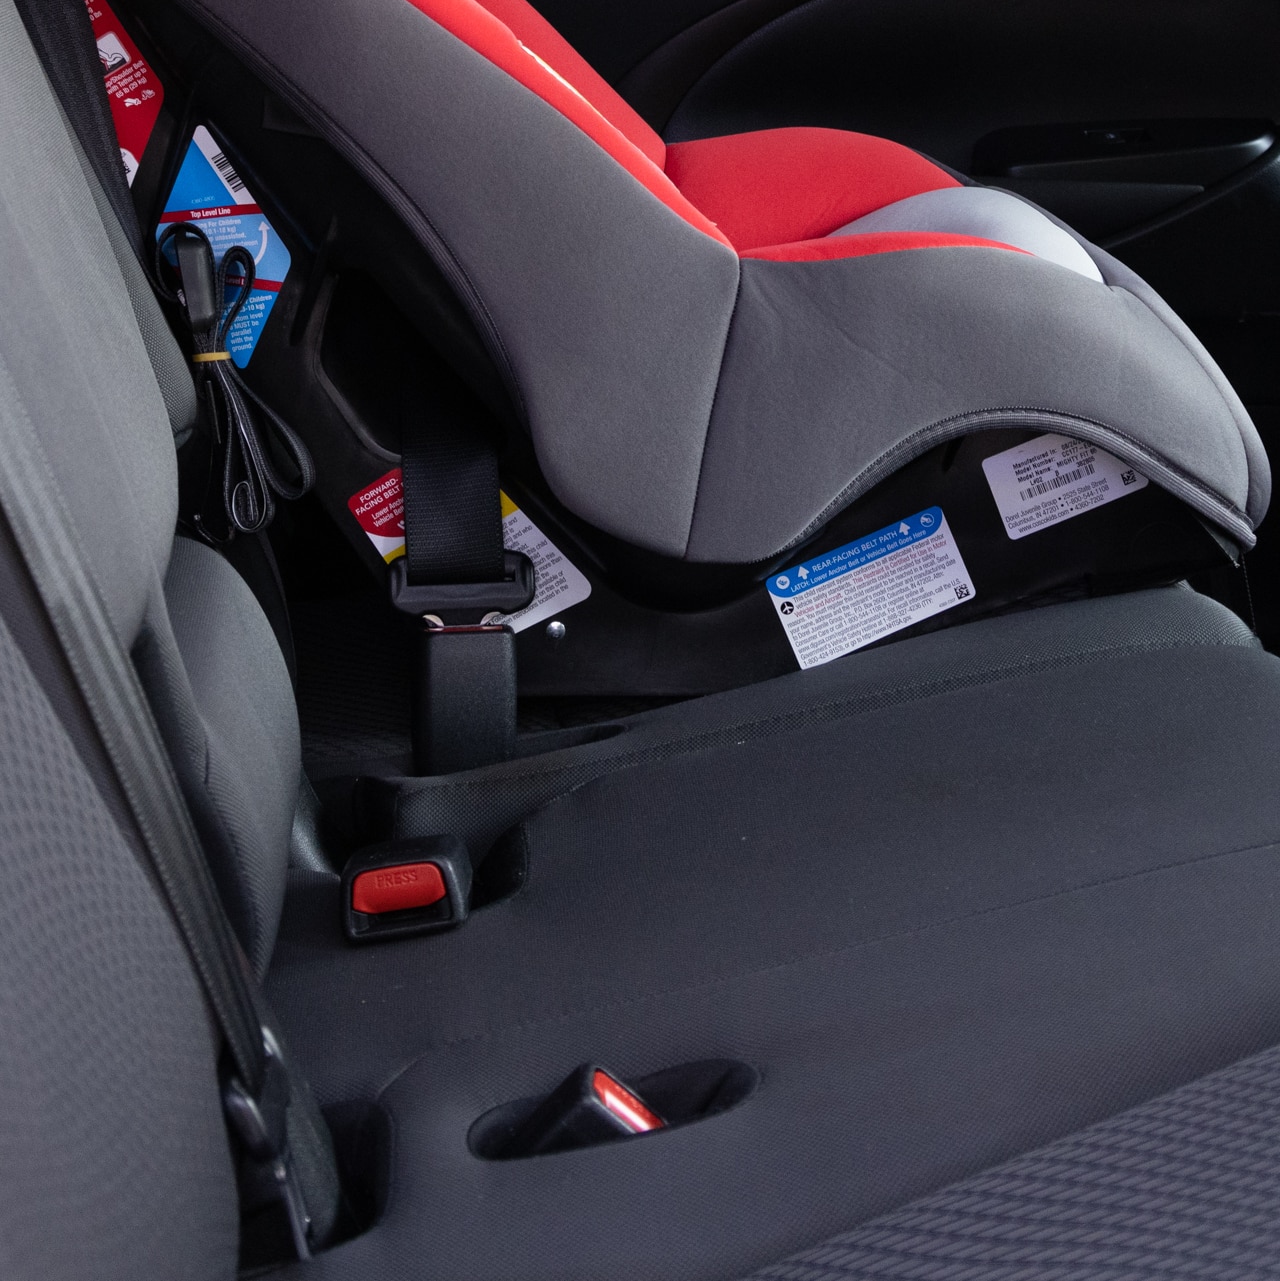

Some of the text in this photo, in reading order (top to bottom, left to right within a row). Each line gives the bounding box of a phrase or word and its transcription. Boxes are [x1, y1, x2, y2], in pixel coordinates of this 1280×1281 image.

[133, 60, 144, 69] Belt
[118, 75, 134, 87] Tether
[134, 71, 142, 79] up
[115, 90, 124, 98] 65
[250, 295, 272, 303] Children
[231, 329, 252, 337] parallel
[232, 343, 252, 352] ground.
[1013, 452, 1048, 469] Manufactured
[1015, 457, 1055, 475] Model Number:
[1018, 473, 1034, 482] Model
[1035, 466, 1052, 476] Name:
[1057, 455, 1078, 468] MIGHTY
[359, 477, 399, 503] FORWARD-
[355, 486, 400, 516] FACING BELT
[1005, 478, 1107, 522] Dorel Juvenile Group 2525 State Street
[371, 506, 389, 520] Lower
[374, 512, 395, 528] Vehicle
[1008, 514, 1036, 529] Columbus,
[1042, 505, 1059, 515] 47201
[508, 517, 517, 526] and
[512, 524, 533, 539] and who
[527, 540, 548, 555] this child
[812, 530, 897, 573] REAR-FACING BELT PATH
[539, 556, 563, 572] more than
[546, 552, 555, 560] this
[791, 580, 810, 593] LATCH:
[811, 572, 828, 584] Lower
[828, 564, 847, 576] Anchor
[848, 558, 859, 568] Belt
[866, 546, 886, 559] Vehicle
[887, 541, 898, 550] Belt
[898, 535, 912, 545] Goes
[912, 529, 926, 539] Here
[545, 584, 555, 592] this
[554, 578, 566, 587] child
[538, 591, 556, 604] located
[376, 870, 418, 888] PRESS
